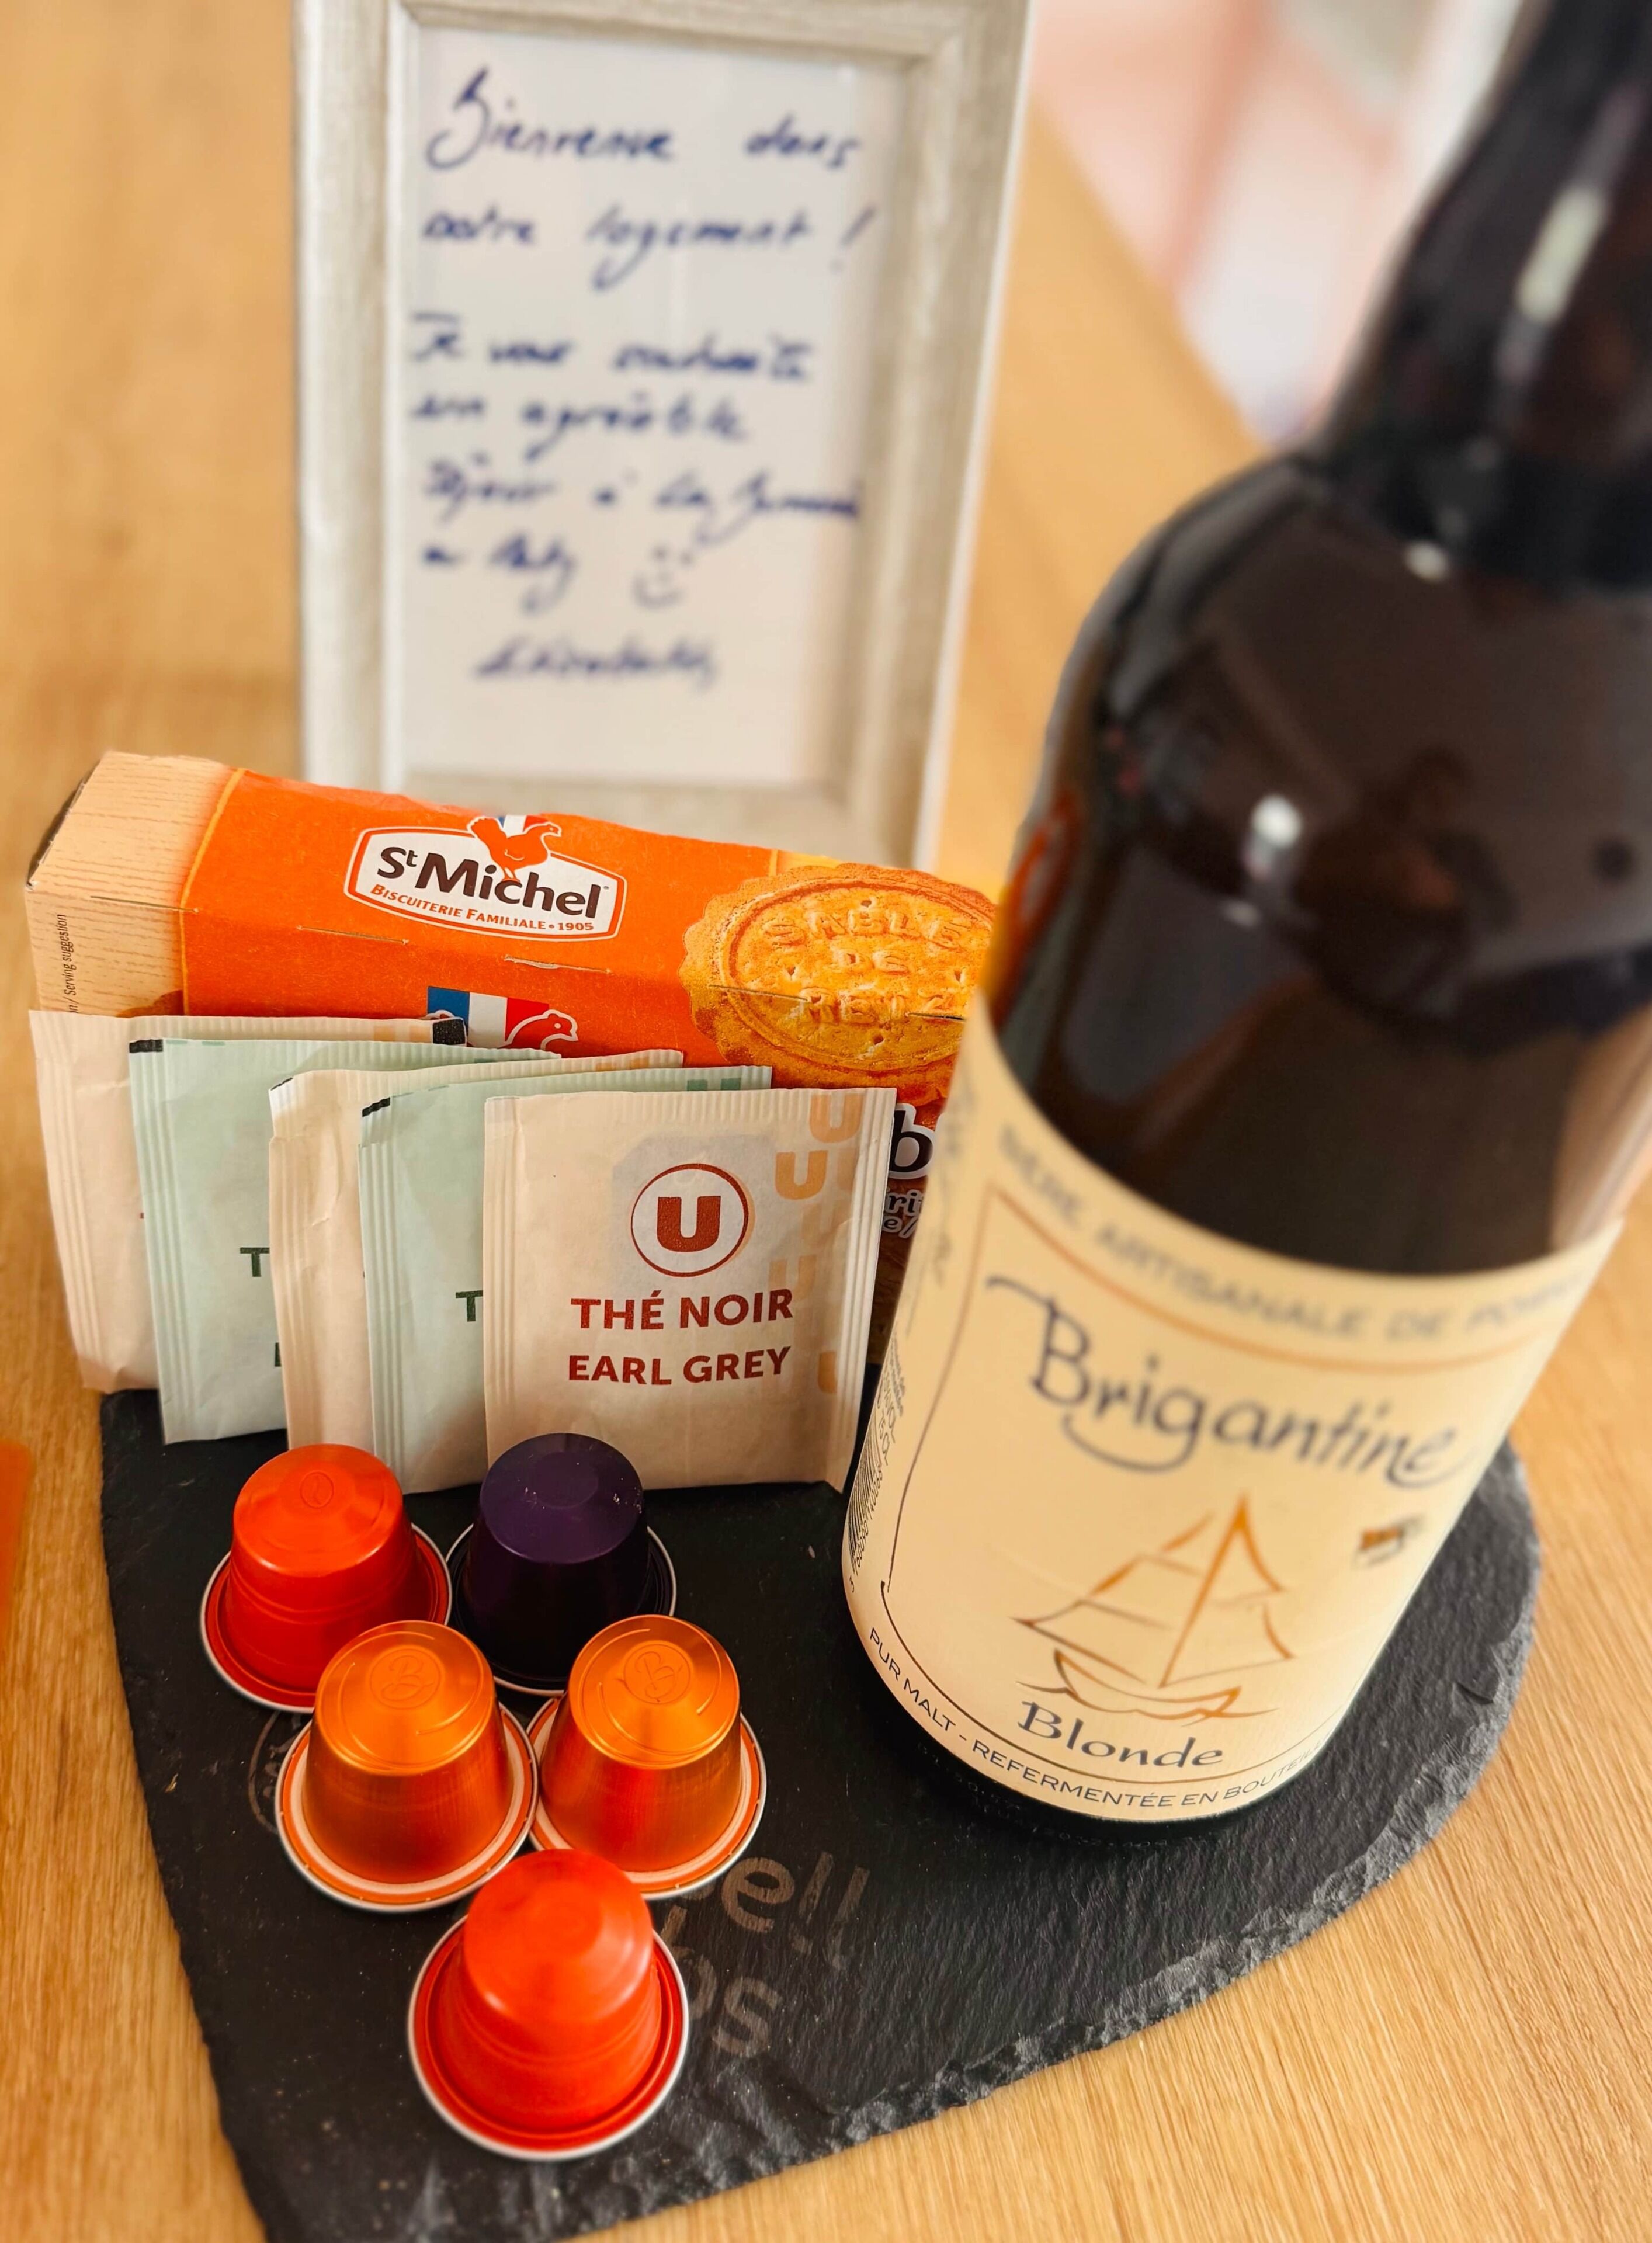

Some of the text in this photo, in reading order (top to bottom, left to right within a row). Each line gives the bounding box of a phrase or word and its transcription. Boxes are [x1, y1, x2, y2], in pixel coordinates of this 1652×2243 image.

[415, 852, 601, 919] Michel
[57, 914, 75, 963] suggestion
[557, 921, 594, 931] 1905
[59, 964, 77, 996] Serving
[657, 1196, 721, 1252] U
[1094, 1223, 1370, 1339] ARTISANALE
[571, 1289, 793, 1330] THÉ NOIR
[568, 1346, 791, 1385] EARL GREY
[986, 1275, 1476, 1488] Brigantine
[870, 1627, 901, 1680] PUR
[904, 1678, 956, 1731] MALT
[973, 1739, 1176, 1807] REFERMENTÉE
[1181, 1791, 1220, 1806] EN
[1017, 1700, 1224, 1768] Blonde
